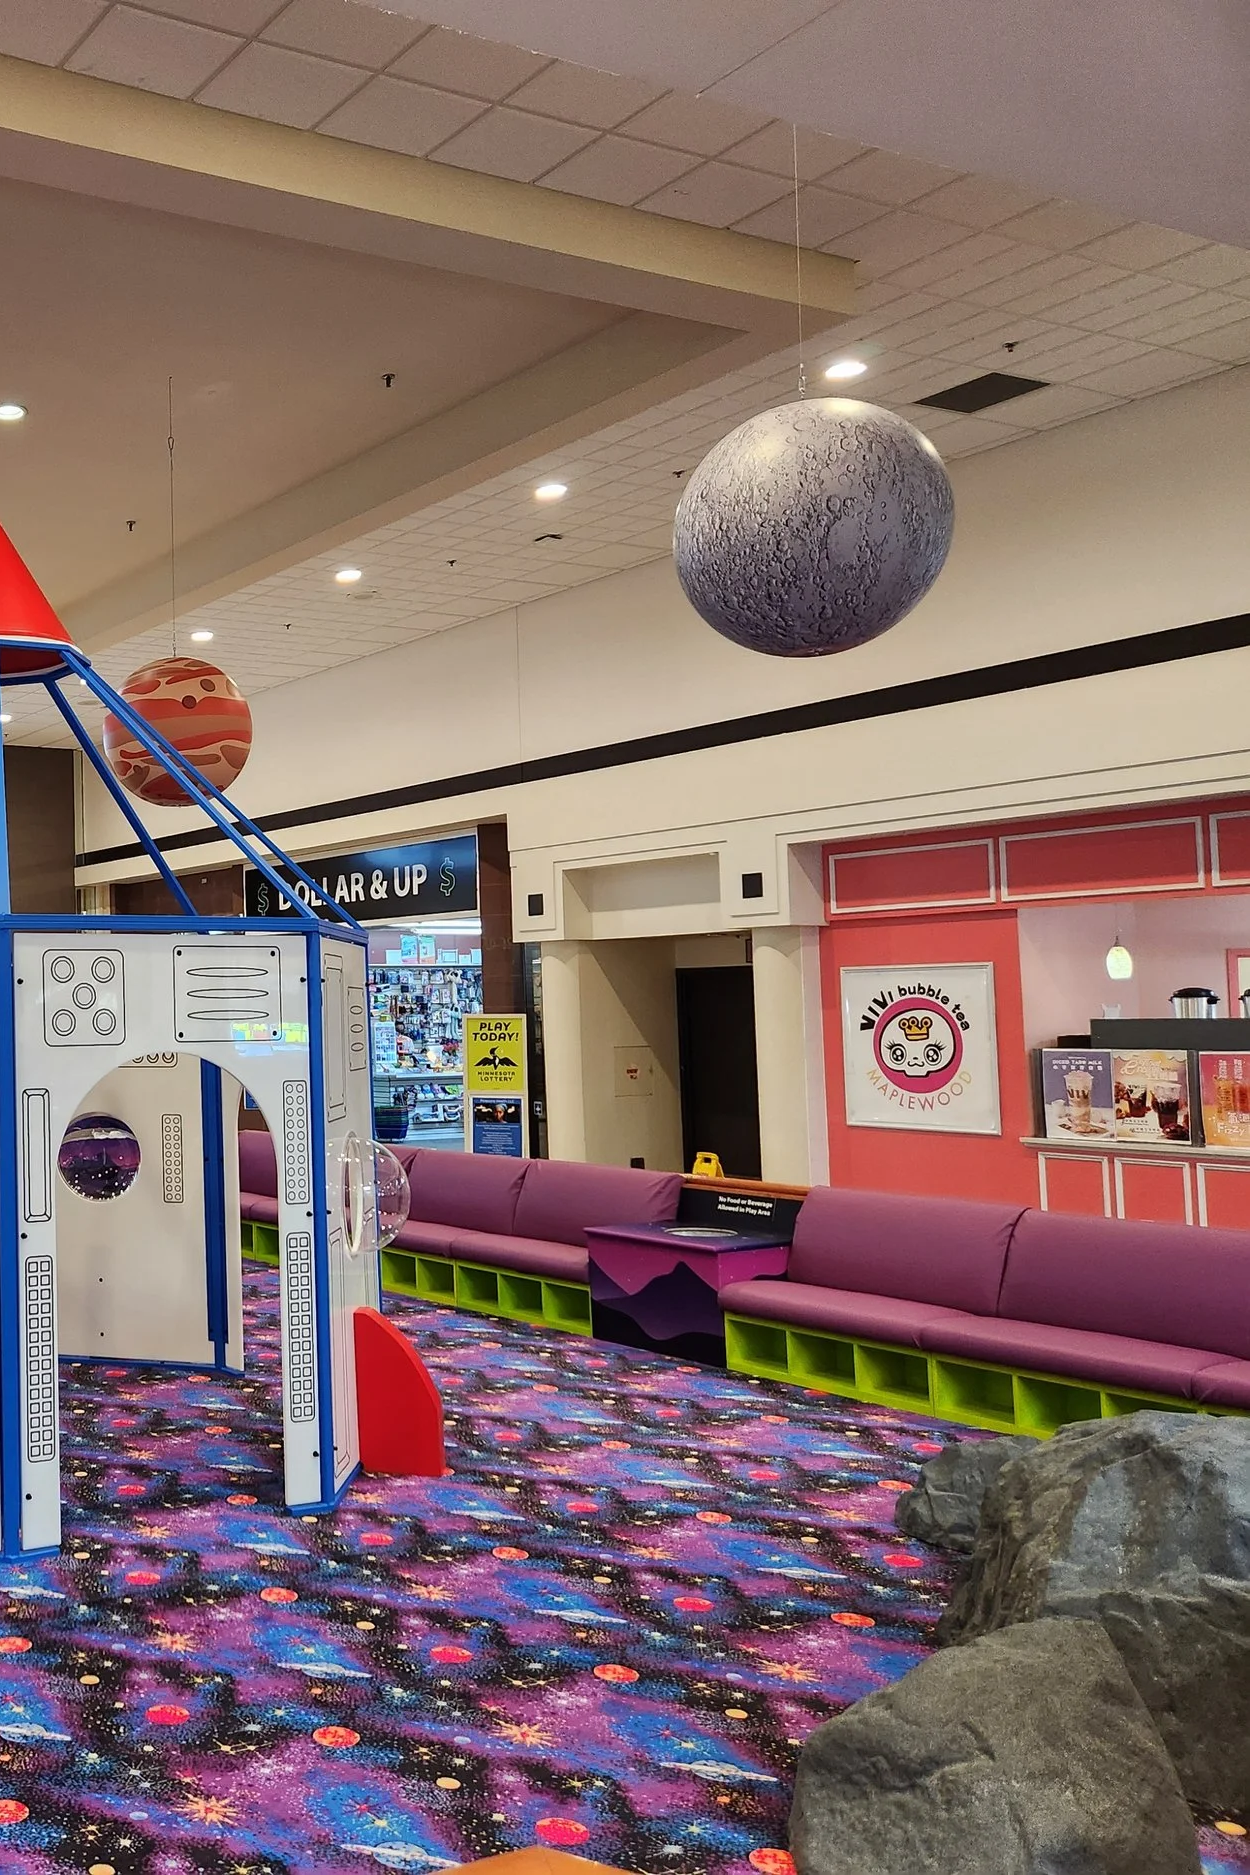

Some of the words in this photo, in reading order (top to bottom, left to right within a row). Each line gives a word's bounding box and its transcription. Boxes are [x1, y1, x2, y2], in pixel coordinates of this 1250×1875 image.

[370, 869, 389, 900] &
[393, 864, 428, 898] UP
[897, 982, 950, 1005] bubble
[951, 1003, 970, 1032] tea
[479, 1022, 511, 1032] PLAY
[472, 1032, 519, 1042] TODAY!
[866, 1068, 972, 1112] MAPLEWOOD
[717, 1204, 739, 1213] Allowed
[745, 1207, 757, 1216] Play
[748, 1199, 773, 1209] Beverage
